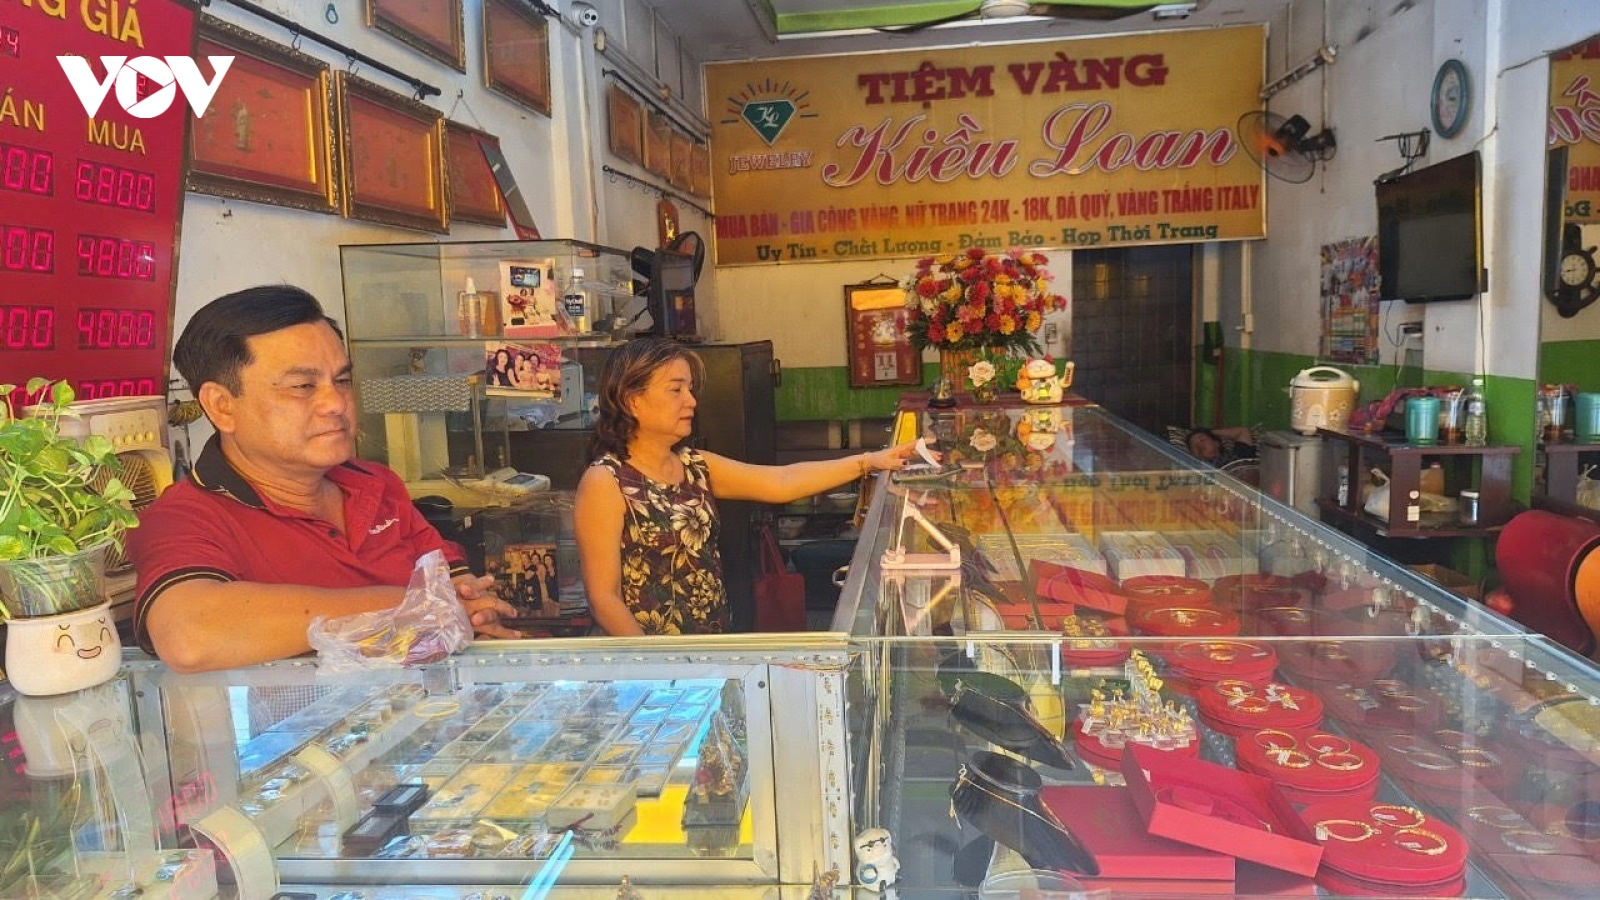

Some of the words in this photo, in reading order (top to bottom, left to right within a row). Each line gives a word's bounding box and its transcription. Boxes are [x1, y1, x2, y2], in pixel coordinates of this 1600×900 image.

[80, 0, 145, 49] GIÁ
[858, 60, 995, 110] TIỆM
[1007, 51, 1169, 95] VÀNG
[87, 117, 146, 155] MUA
[821, 113, 1021, 188] Kiều
[1028, 102, 1238, 178] Loan
[75, 161, 154, 211] 6800
[716, 214, 747, 240] MUA
[750, 210, 779, 237] BÁN
[789, 209, 814, 236] GIA
[817, 204, 857, 234] CÔNG
[929, 200, 978, 227] TRANG
[981, 199, 1011, 224] 24K
[1117, 188, 1159, 216] VÀNG
[1217, 184, 1260, 211] ITALY
[77, 238, 154, 279] 4800
[757, 245, 782, 262] Uy
[1157, 223, 1218, 239] Trang
[77, 309, 154, 348] 4000
